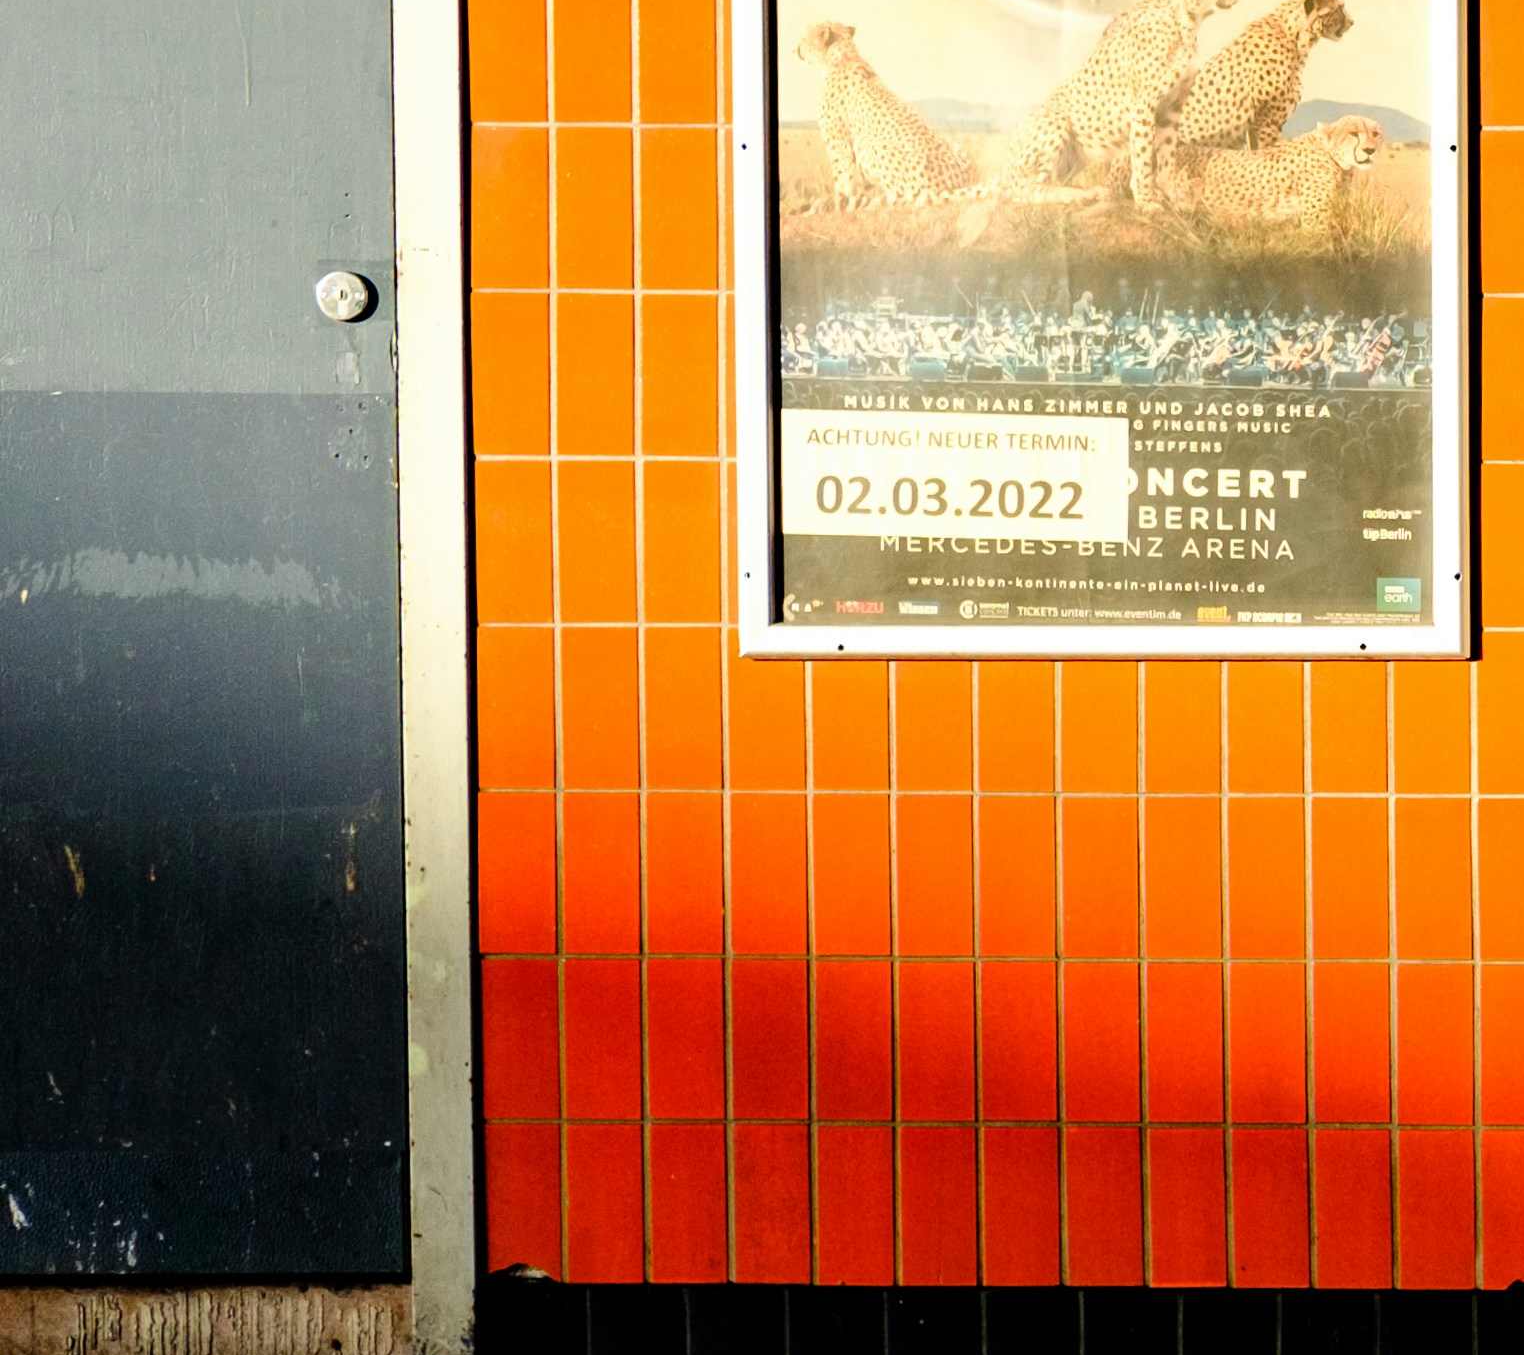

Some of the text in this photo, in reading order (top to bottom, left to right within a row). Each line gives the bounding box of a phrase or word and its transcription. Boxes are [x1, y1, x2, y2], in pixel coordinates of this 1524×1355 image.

[844, 395, 1331, 419] MUSIK VON HANS ZIMMER UND JACOB SHEA
[1153, 420, 1228, 433] FINGERS
[1237, 421, 1292, 434] MUSIC
[806, 428, 1096, 452] ACHTUNG! NEUER TERMIN:
[1133, 440, 1223, 454] STEFFENS
[816, 475, 1084, 520] 02.03.2022
[1138, 506, 1276, 532] BERLIN
[880, 535, 1295, 560] MERCEDES-BENZ ARENA
